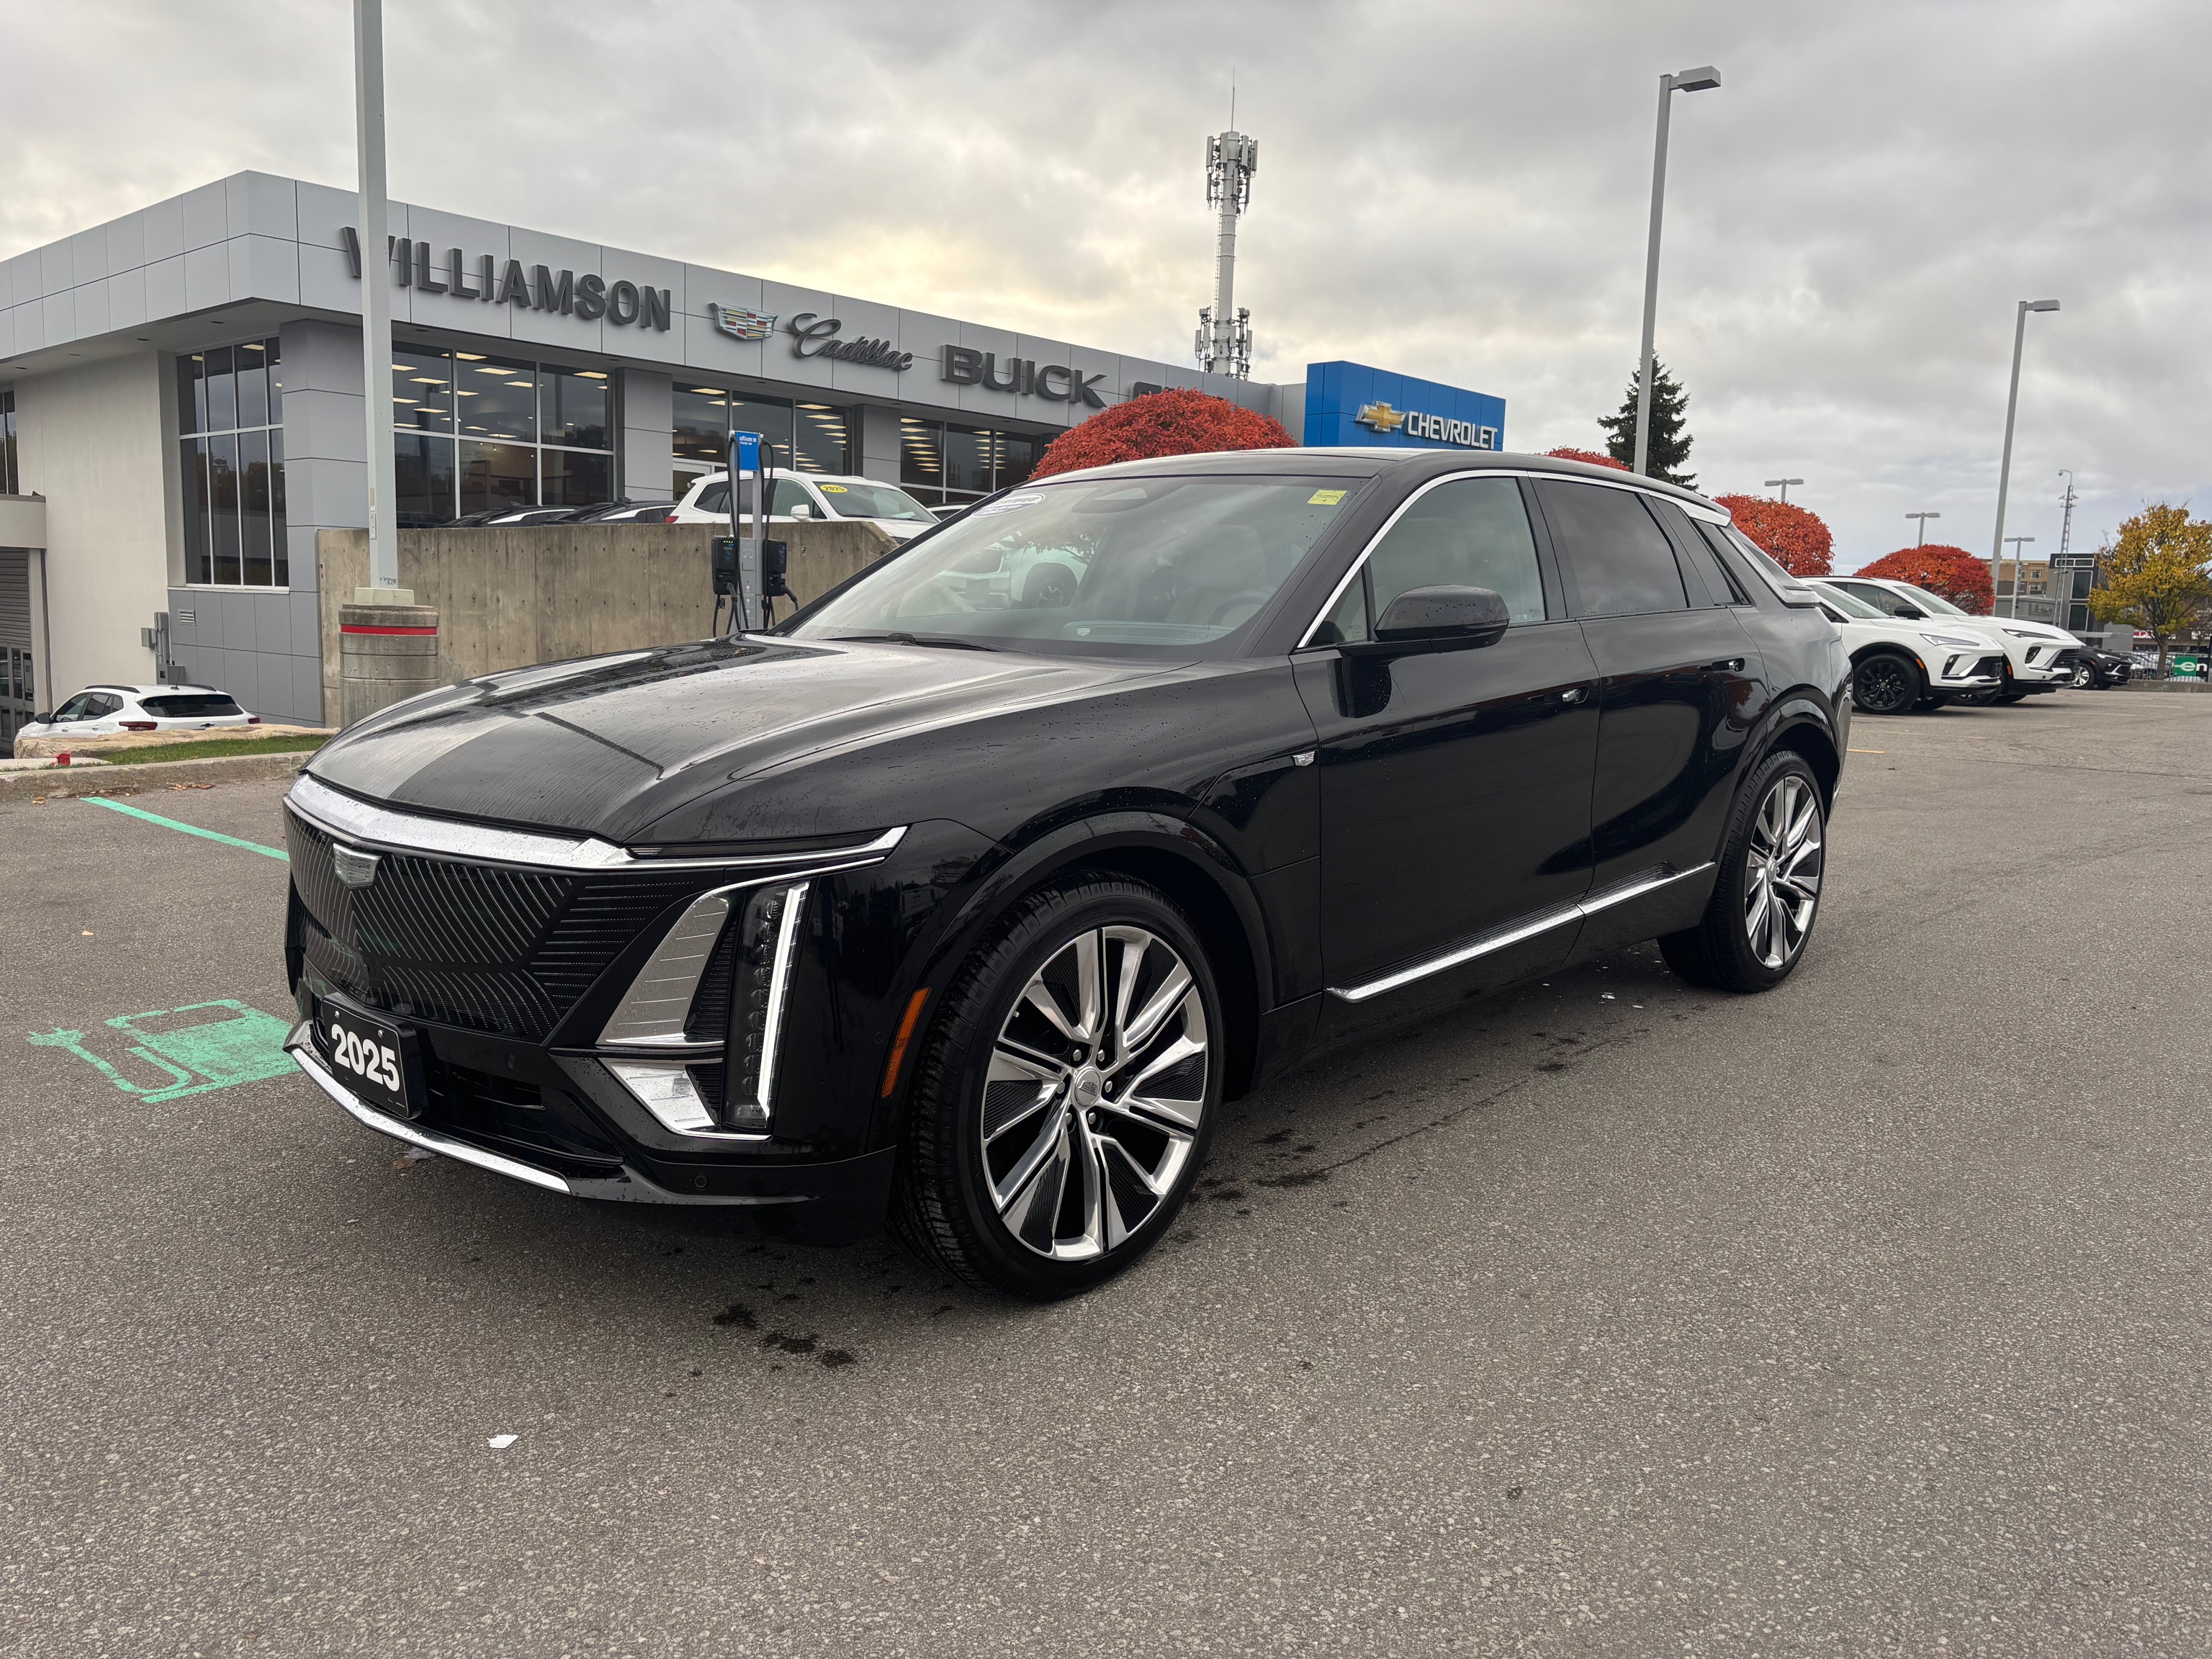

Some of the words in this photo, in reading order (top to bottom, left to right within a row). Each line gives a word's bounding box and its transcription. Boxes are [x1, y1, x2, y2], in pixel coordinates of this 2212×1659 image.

[791, 313, 914, 372] Cadillac
[940, 343, 1107, 408] BUICK
[1408, 410, 1498, 450] CHEVROLET
[331, 1023, 400, 1092] 2025
